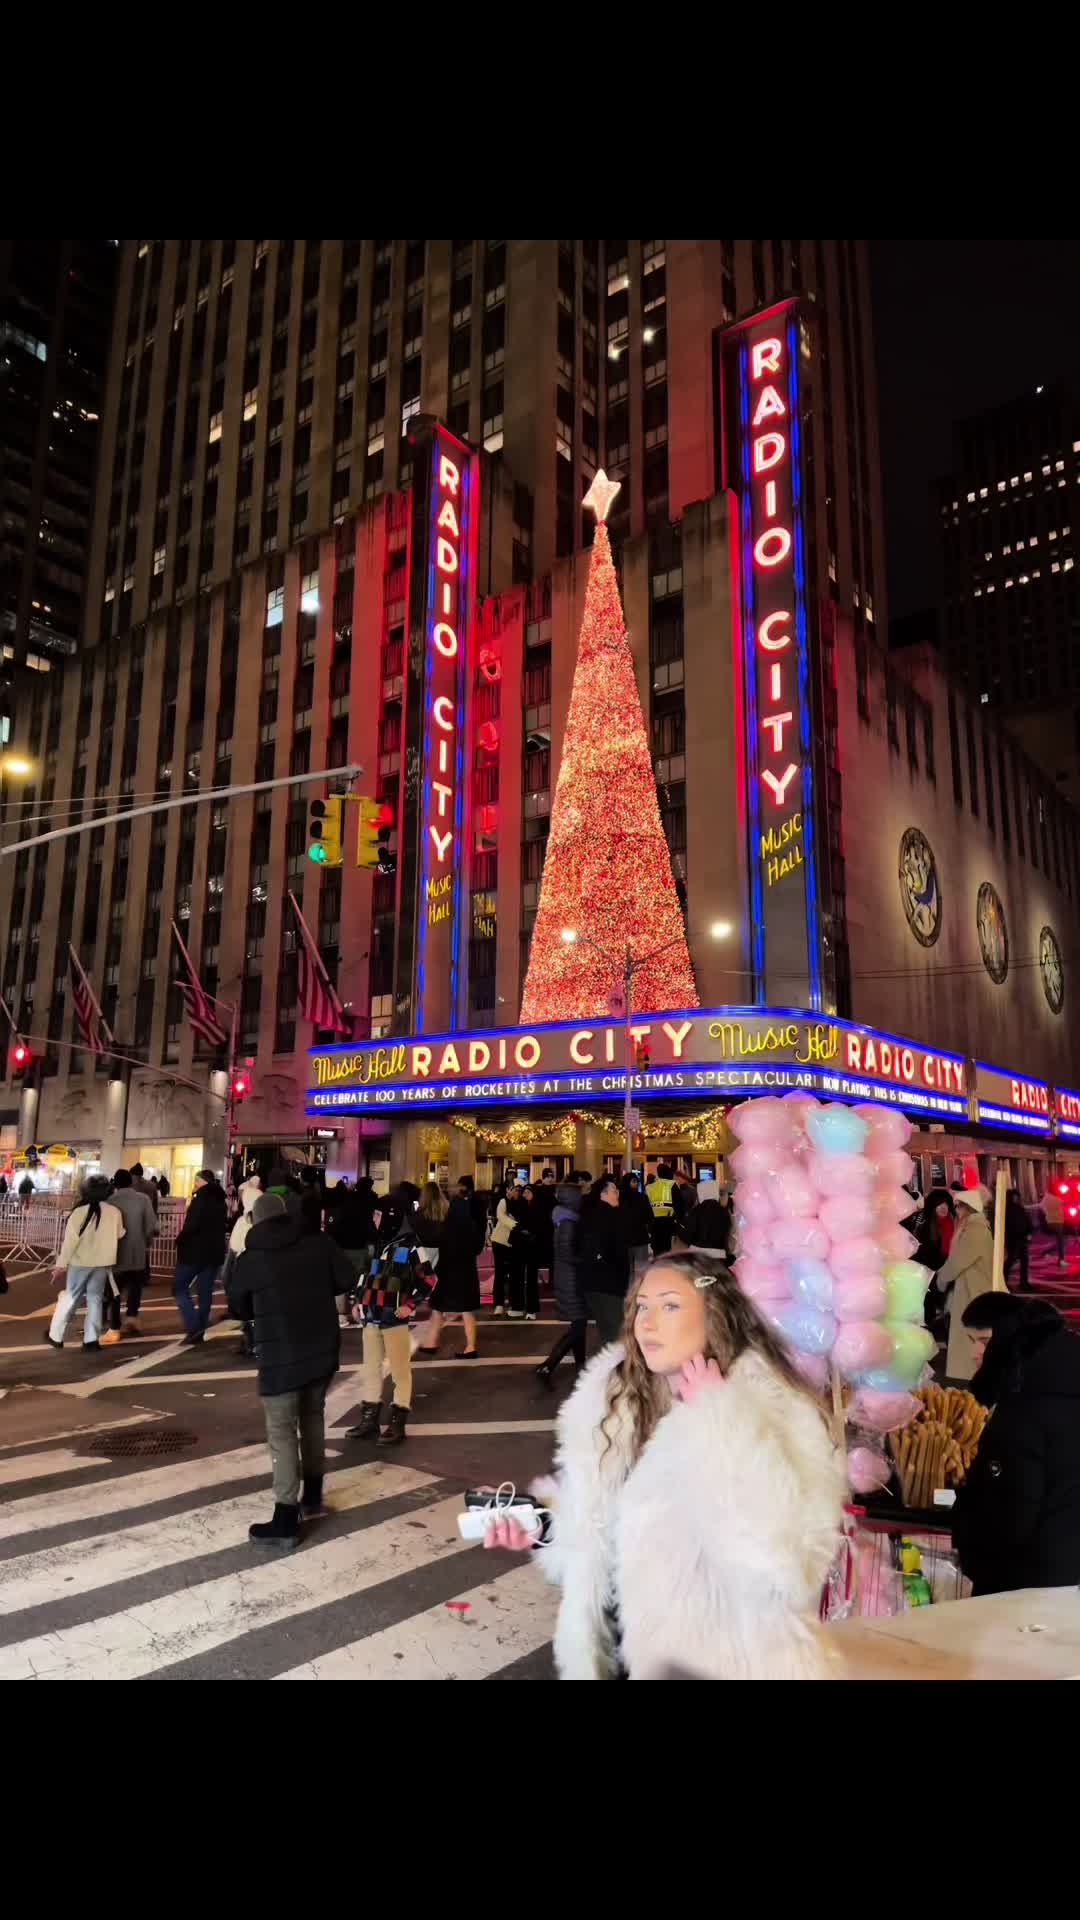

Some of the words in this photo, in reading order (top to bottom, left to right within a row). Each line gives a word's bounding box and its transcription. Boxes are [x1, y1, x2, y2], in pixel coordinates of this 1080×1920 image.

[751, 337, 792, 567] RADIO
[433, 455, 460, 657] RADIO
[758, 610, 798, 806] CITY
[428, 695, 455, 862] CITY
[760, 812, 803, 861] MUSIC
[425, 873, 452, 900] MUSIC
[767, 842, 804, 889] HALL
[427, 896, 451, 929] HALL
[312, 1054, 362, 1085] Music
[359, 1044, 408, 1084] Hall
[411, 1036, 541, 1077] RADIO
[569, 1021, 692, 1065] CITY
[708, 1022, 799, 1058] Music
[795, 1024, 840, 1063] Hall
[846, 1033, 915, 1080] RADIO
[923, 1055, 965, 1091] CITY
[313, 1091, 370, 1106] CELEBRATE
[375, 1089, 396, 1102] 100
[401, 1087, 436, 1100] YEARS
[442, 1085, 460, 1097] OF
[465, 1081, 536, 1097] ROCKETTES
[543, 1079, 560, 1091] AT
[570, 1077, 593, 1090] THE
[1011, 1079, 1049, 1111] RADIO
